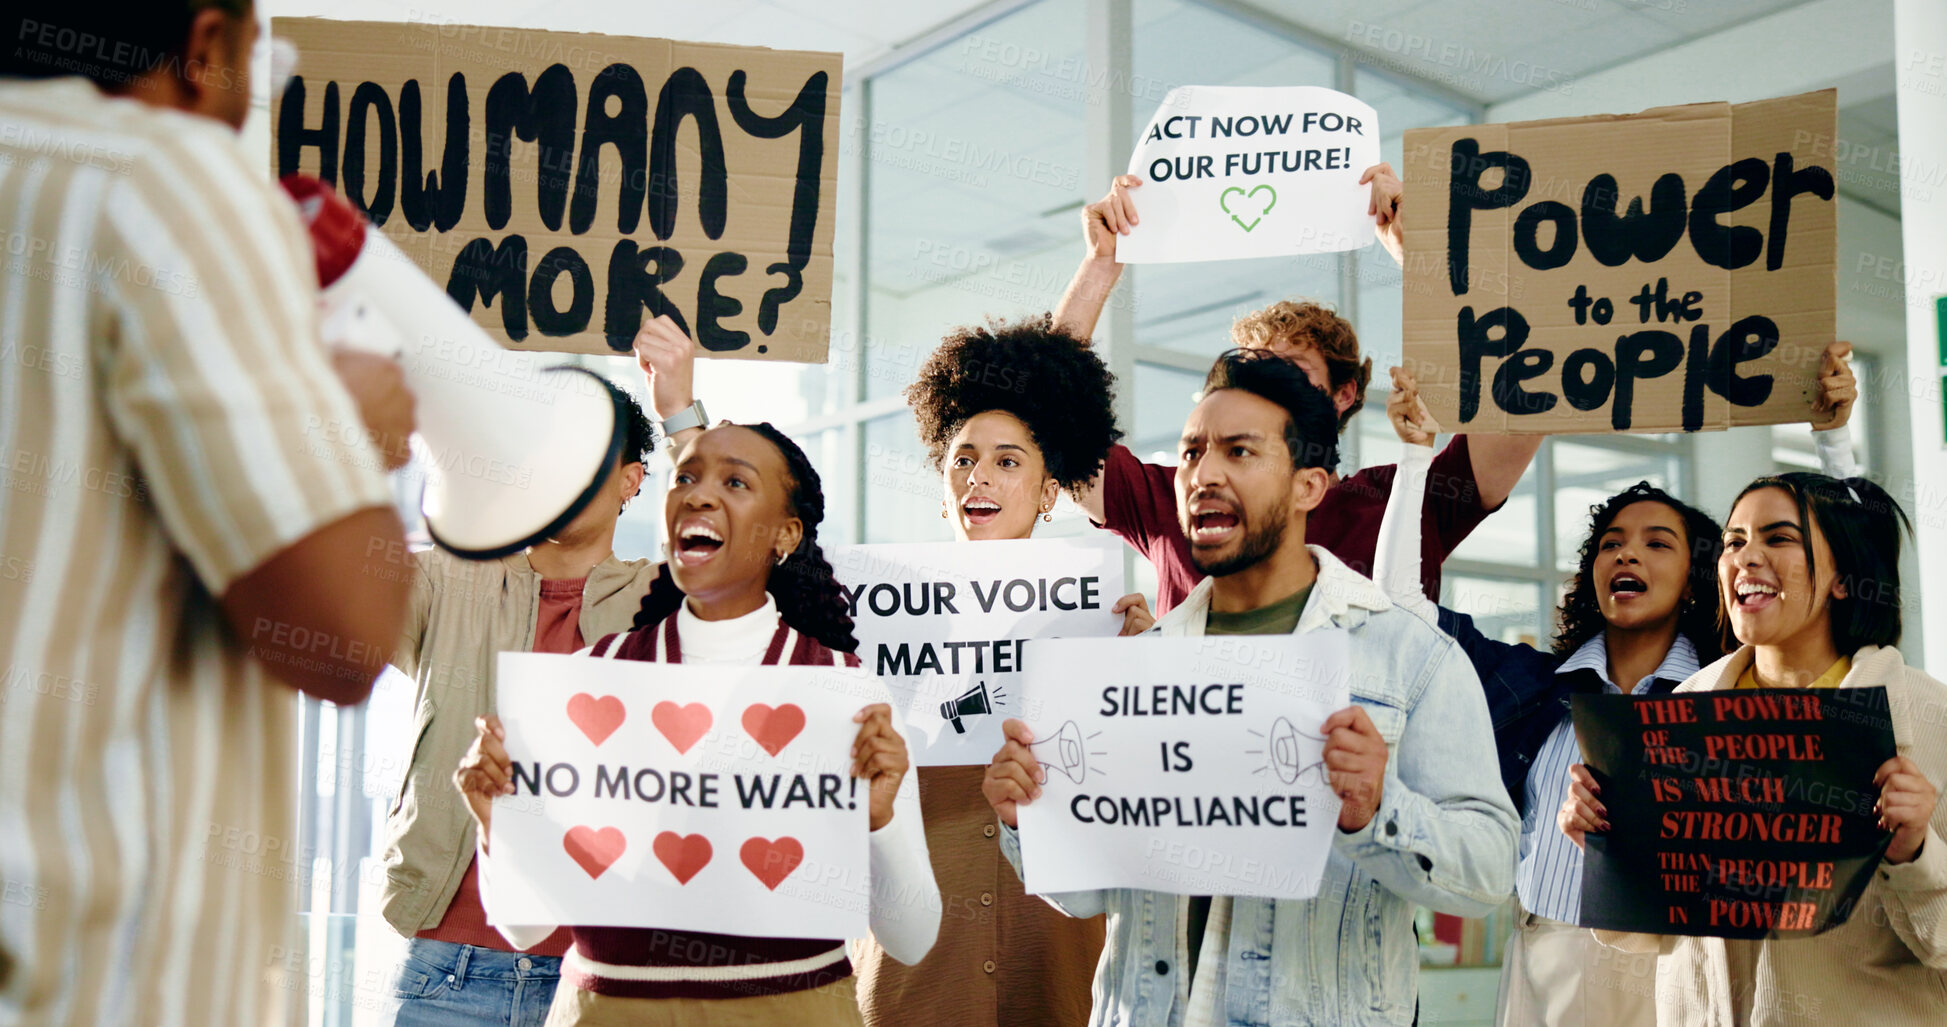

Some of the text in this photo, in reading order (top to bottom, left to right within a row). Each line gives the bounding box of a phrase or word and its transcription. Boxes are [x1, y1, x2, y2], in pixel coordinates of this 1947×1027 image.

[1145, 112, 1364, 144] ACT NOW FOR
[278, 63, 828, 270] HOW MANY
[1150, 147, 1350, 182] OUR FUTURE!
[447, 234, 802, 353] MORE?
[1568, 277, 1704, 325] to the
[842, 576, 1100, 617] YOUR VOICE
[877, 638, 1031, 676] MATTE
[1100, 684, 1244, 716] SILENCE
[1634, 695, 1823, 725] THE POWER
[1642, 730, 1669, 746] OF
[1704, 734, 1824, 761] PEOPLE
[1161, 741, 1193, 772] IS
[1645, 746, 1689, 764] THE
[511, 762, 580, 797] NO
[594, 765, 719, 808] MORE
[735, 774, 856, 811] WAR!
[1652, 778, 1785, 803] IS MUCH
[1071, 794, 1307, 827] COMPLIANCE
[1660, 811, 1843, 843] STRONGER
[1657, 852, 1711, 871] THAN
[1718, 859, 1834, 889] PEOPLE
[1661, 874, 1700, 892] THE
[1669, 906, 1688, 924] IN
[1709, 900, 1818, 930] POWER
